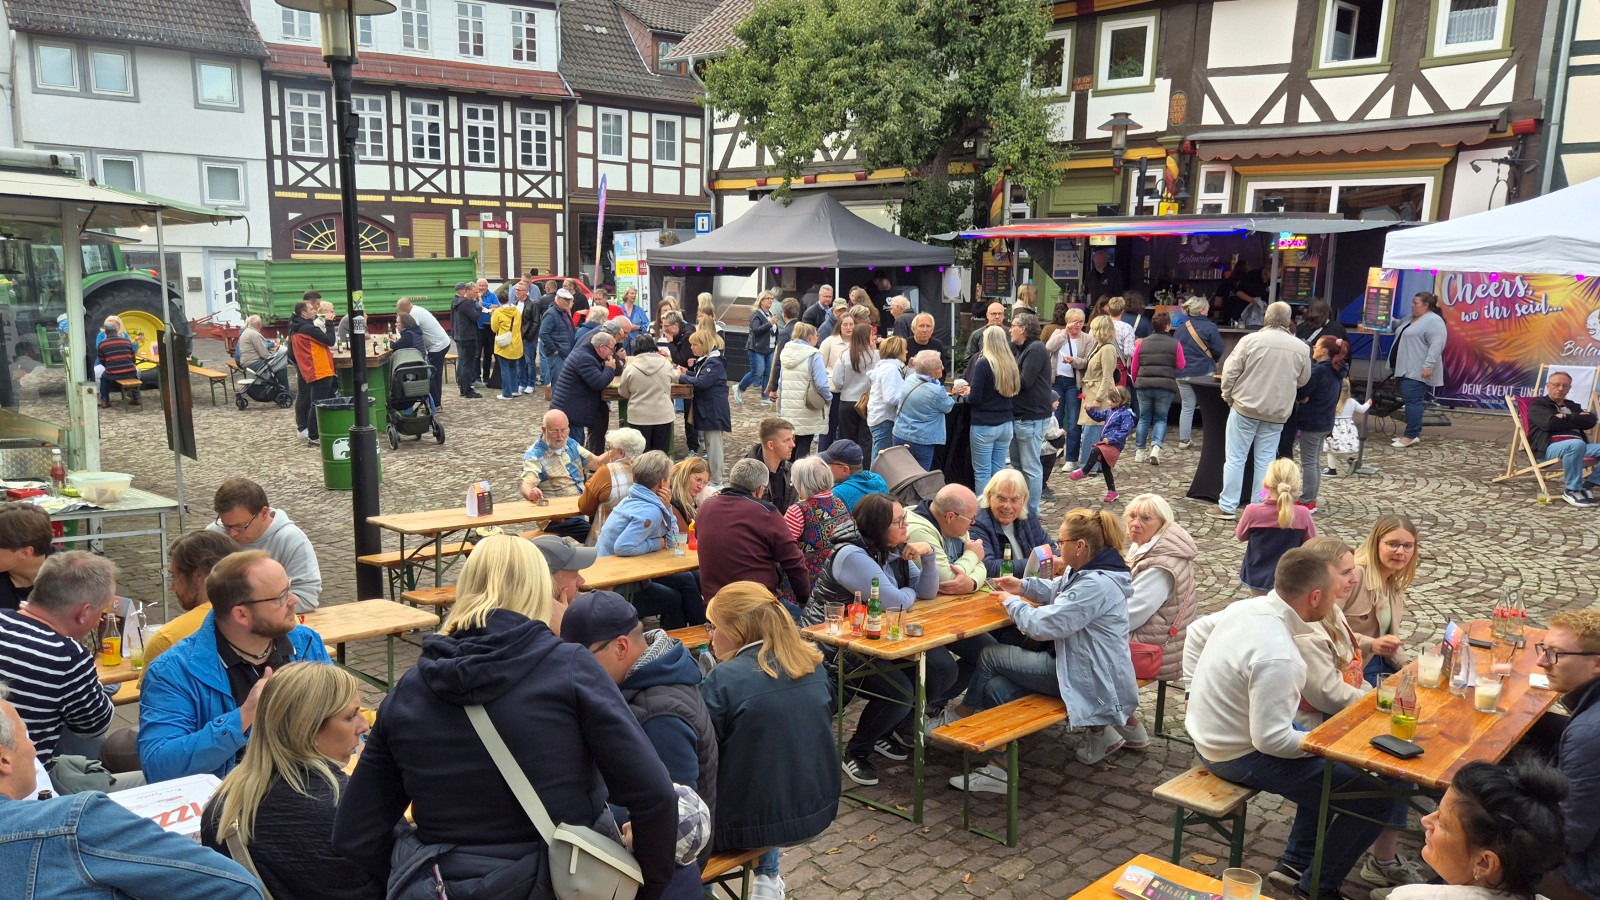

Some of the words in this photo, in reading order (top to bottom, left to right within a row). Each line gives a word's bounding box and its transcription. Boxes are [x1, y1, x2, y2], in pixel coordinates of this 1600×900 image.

[1279, 240, 1305, 248] OPEN
[1441, 273, 1533, 306] Cheers,
[1461, 311, 1479, 322] wo
[1484, 301, 1510, 319] ihr
[1515, 294, 1562, 316] seid...
[1560, 340, 1600, 357] Bala
[1462, 383, 1482, 395] DEIN
[1486, 384, 1515, 398] EVENT,
